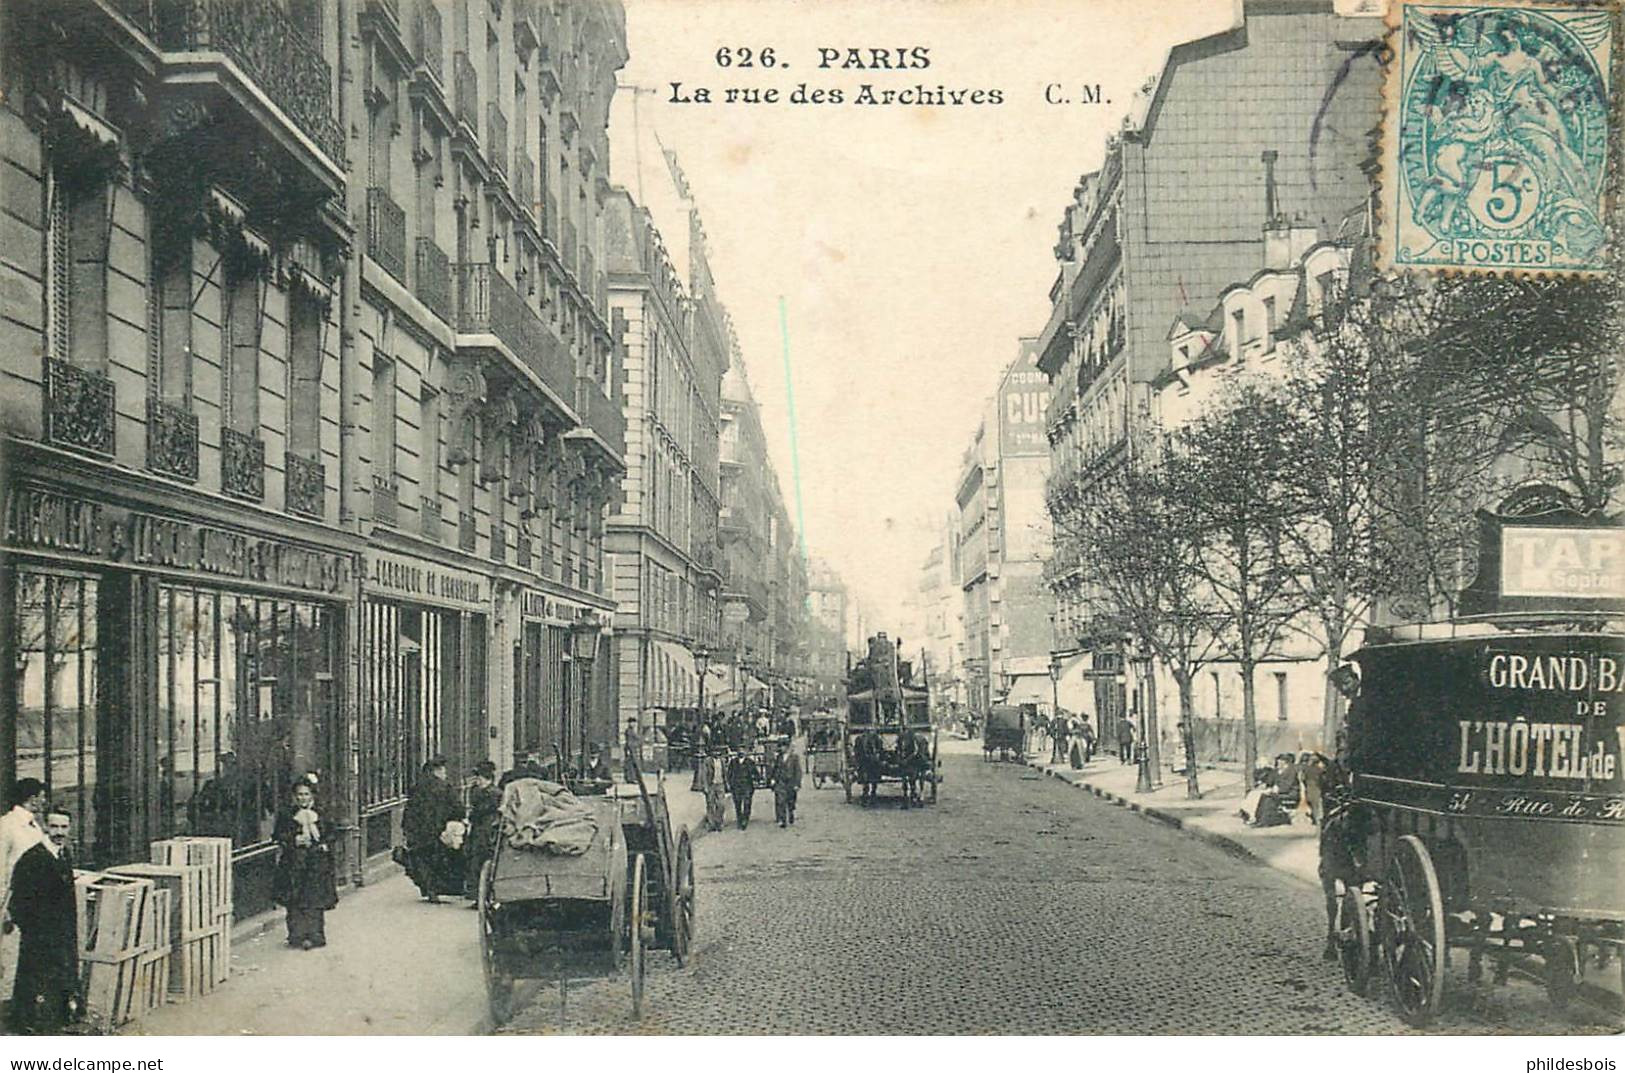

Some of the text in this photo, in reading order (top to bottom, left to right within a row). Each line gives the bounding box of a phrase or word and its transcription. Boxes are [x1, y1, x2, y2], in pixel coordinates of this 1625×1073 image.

[1456, 241, 1546, 263] POSTES
[1489, 654, 1588, 691] GRAND
[1576, 701, 1607, 716] DE
[1457, 716, 1588, 779] L'HÔTEL
[1591, 741, 1615, 780] de
[1495, 795, 1554, 815] Rue
[1557, 799, 1587, 816] de
